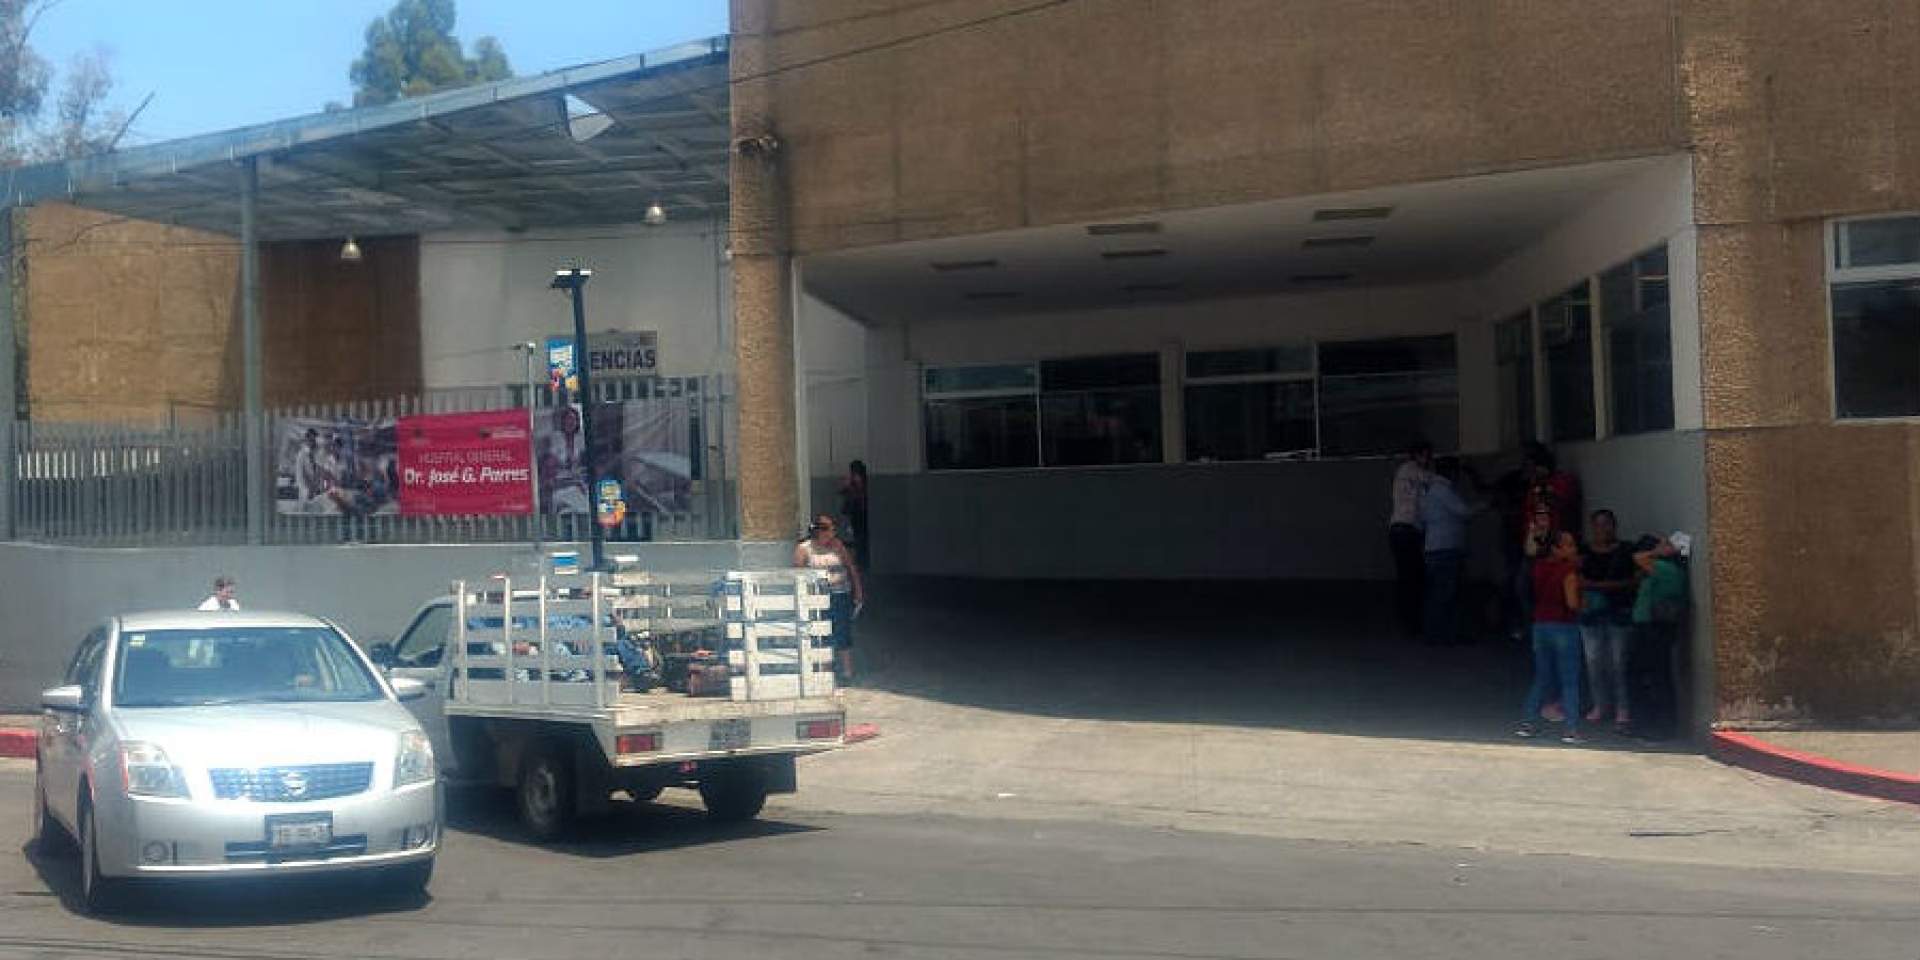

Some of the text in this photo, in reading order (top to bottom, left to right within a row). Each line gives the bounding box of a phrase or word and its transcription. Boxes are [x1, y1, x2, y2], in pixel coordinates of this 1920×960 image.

[590, 349, 656, 370] ENCIAS
[404, 465, 529, 488] Dr. José G. Parres
